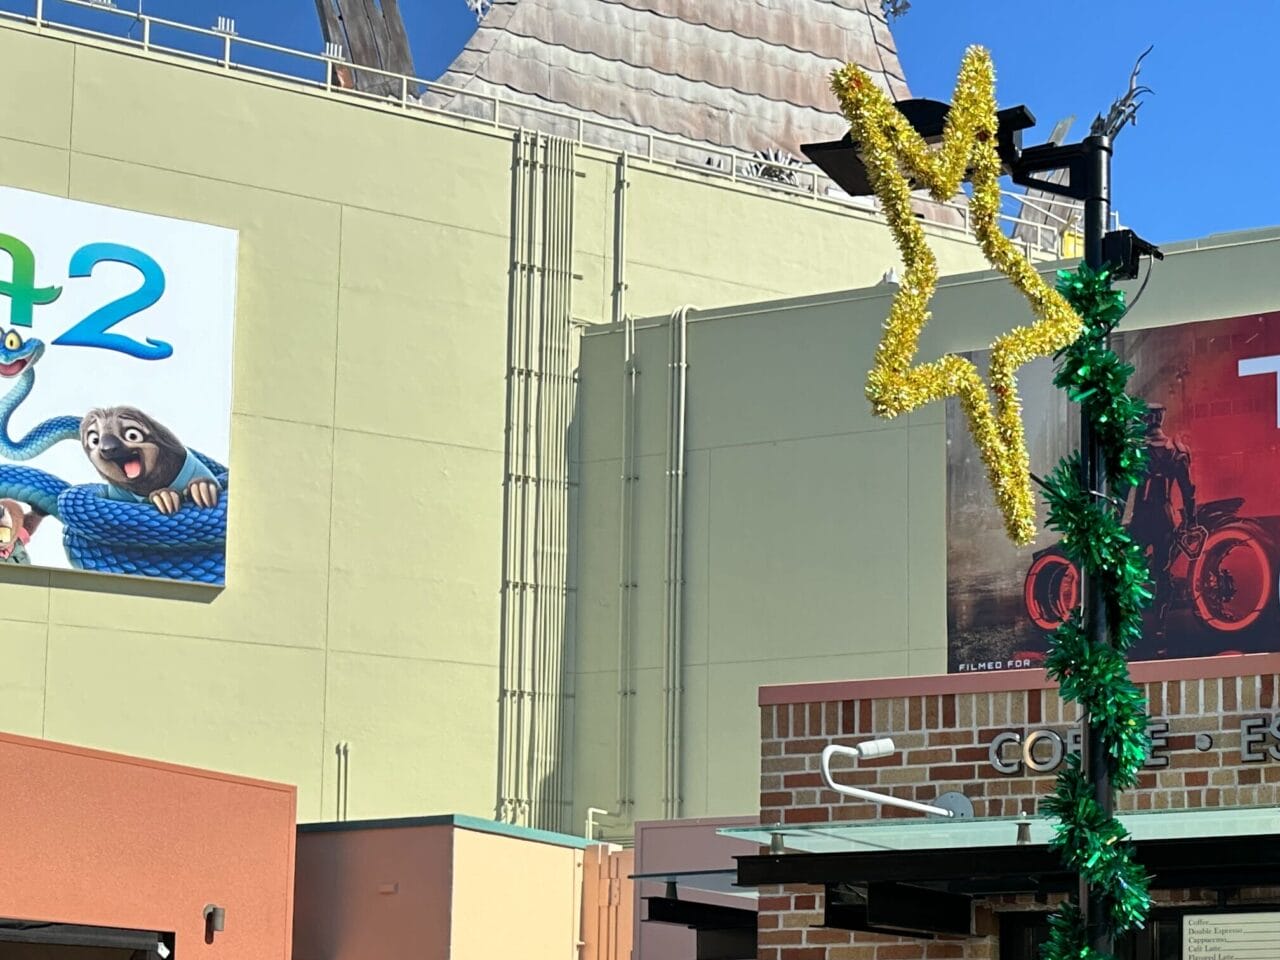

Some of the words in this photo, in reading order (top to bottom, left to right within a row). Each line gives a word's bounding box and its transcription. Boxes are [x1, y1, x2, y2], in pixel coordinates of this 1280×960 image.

[51, 242, 173, 361] 2
[959, 661, 1002, 671] FILMED
[1007, 659, 1031, 668] FOR
[1188, 919, 1209, 927] Coffee
[1188, 927, 1212, 935] Double
